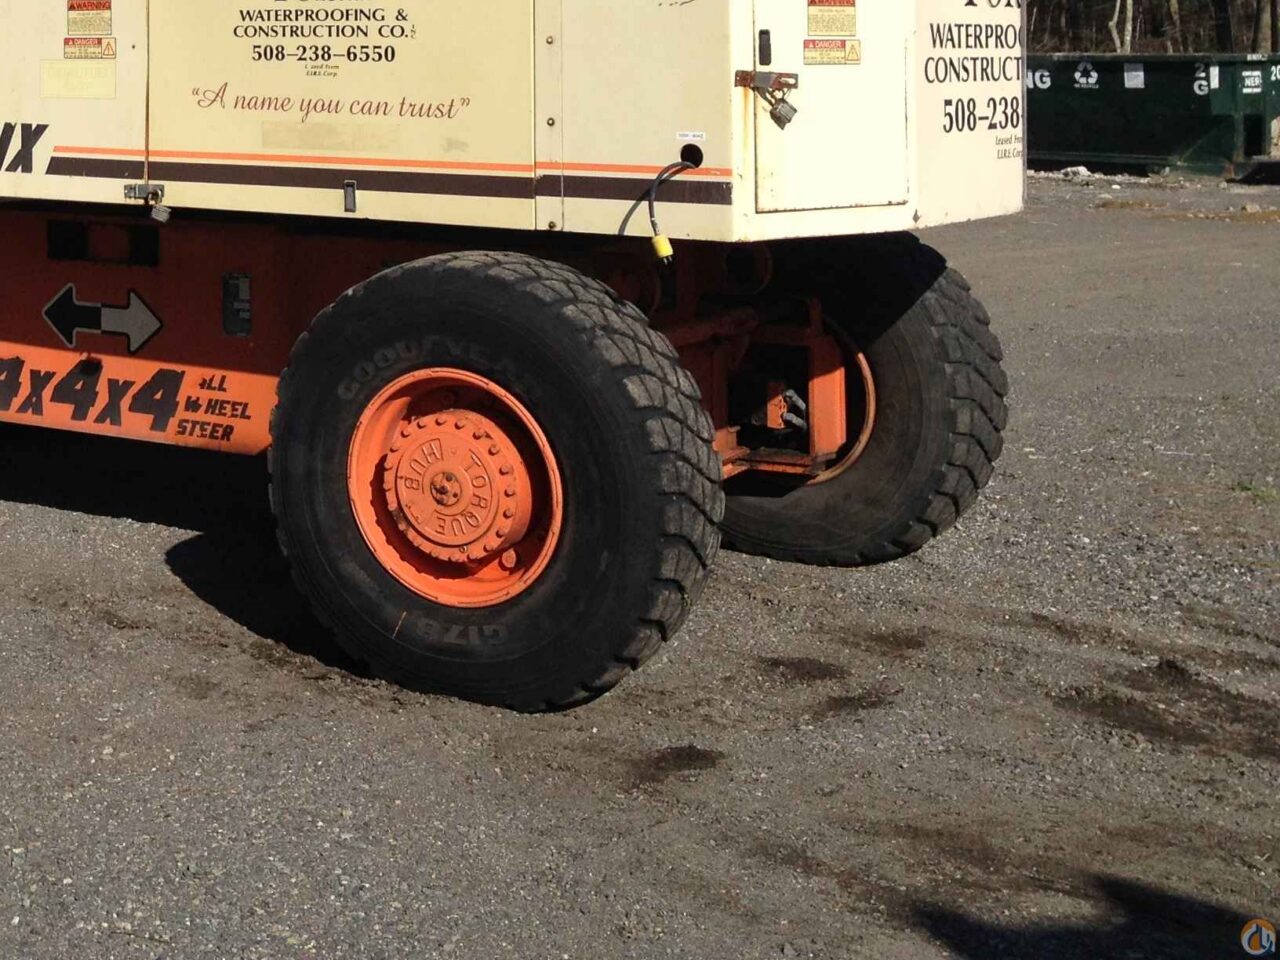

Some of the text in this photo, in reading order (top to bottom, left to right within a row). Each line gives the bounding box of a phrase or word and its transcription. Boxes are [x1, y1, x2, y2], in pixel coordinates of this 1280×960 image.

[239, 8, 408, 22] WATERPROOFING &
[233, 24, 369, 38] CONSTRUCTION
[378, 24, 408, 38] CO.
[929, 22, 1022, 49] WATERPRO
[251, 44, 396, 62] 508-238-6550
[233, 94, 295, 113] name
[299, 98, 345, 123] you
[349, 98, 394, 117] can
[175, 419, 235, 442] STEER
[404, 442, 441, 491] HUB
[434, 452, 489, 537] TORQUE
